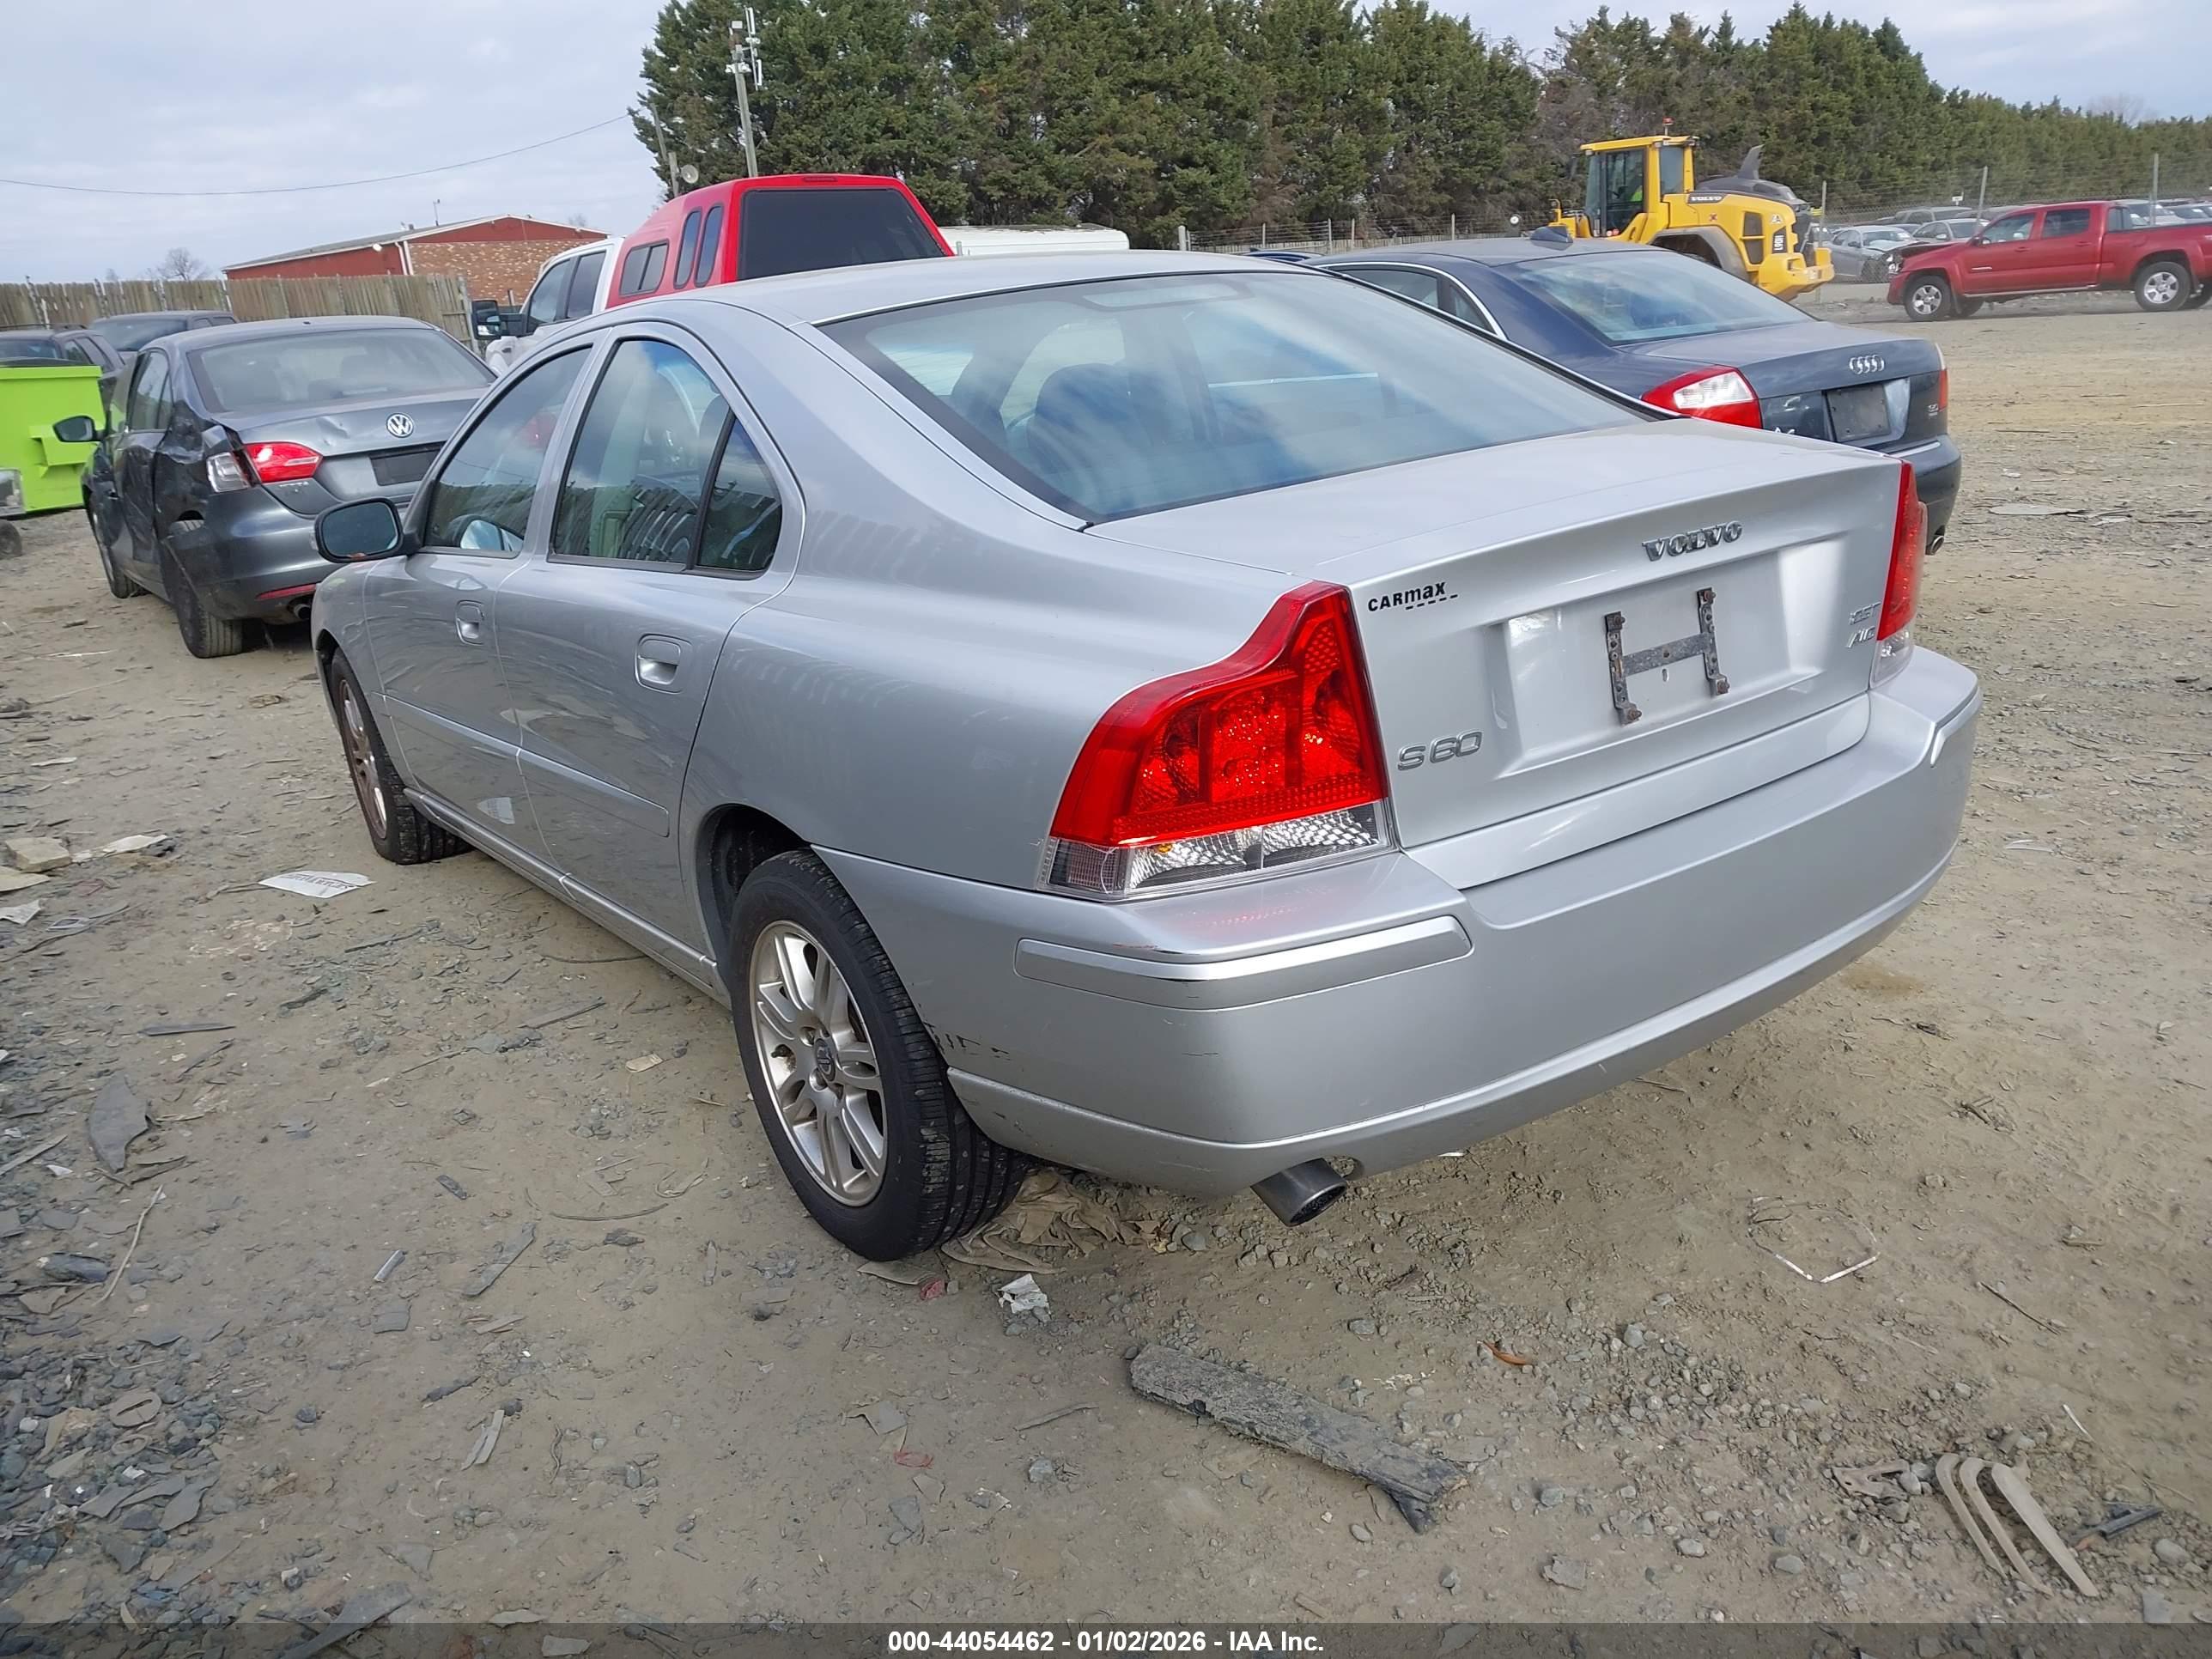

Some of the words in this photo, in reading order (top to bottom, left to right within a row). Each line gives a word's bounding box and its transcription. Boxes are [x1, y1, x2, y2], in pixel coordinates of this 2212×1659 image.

[1642, 520, 1742, 562] VOLVO
[1368, 582, 1446, 611] CARmax
[1397, 731, 1483, 771] S60
